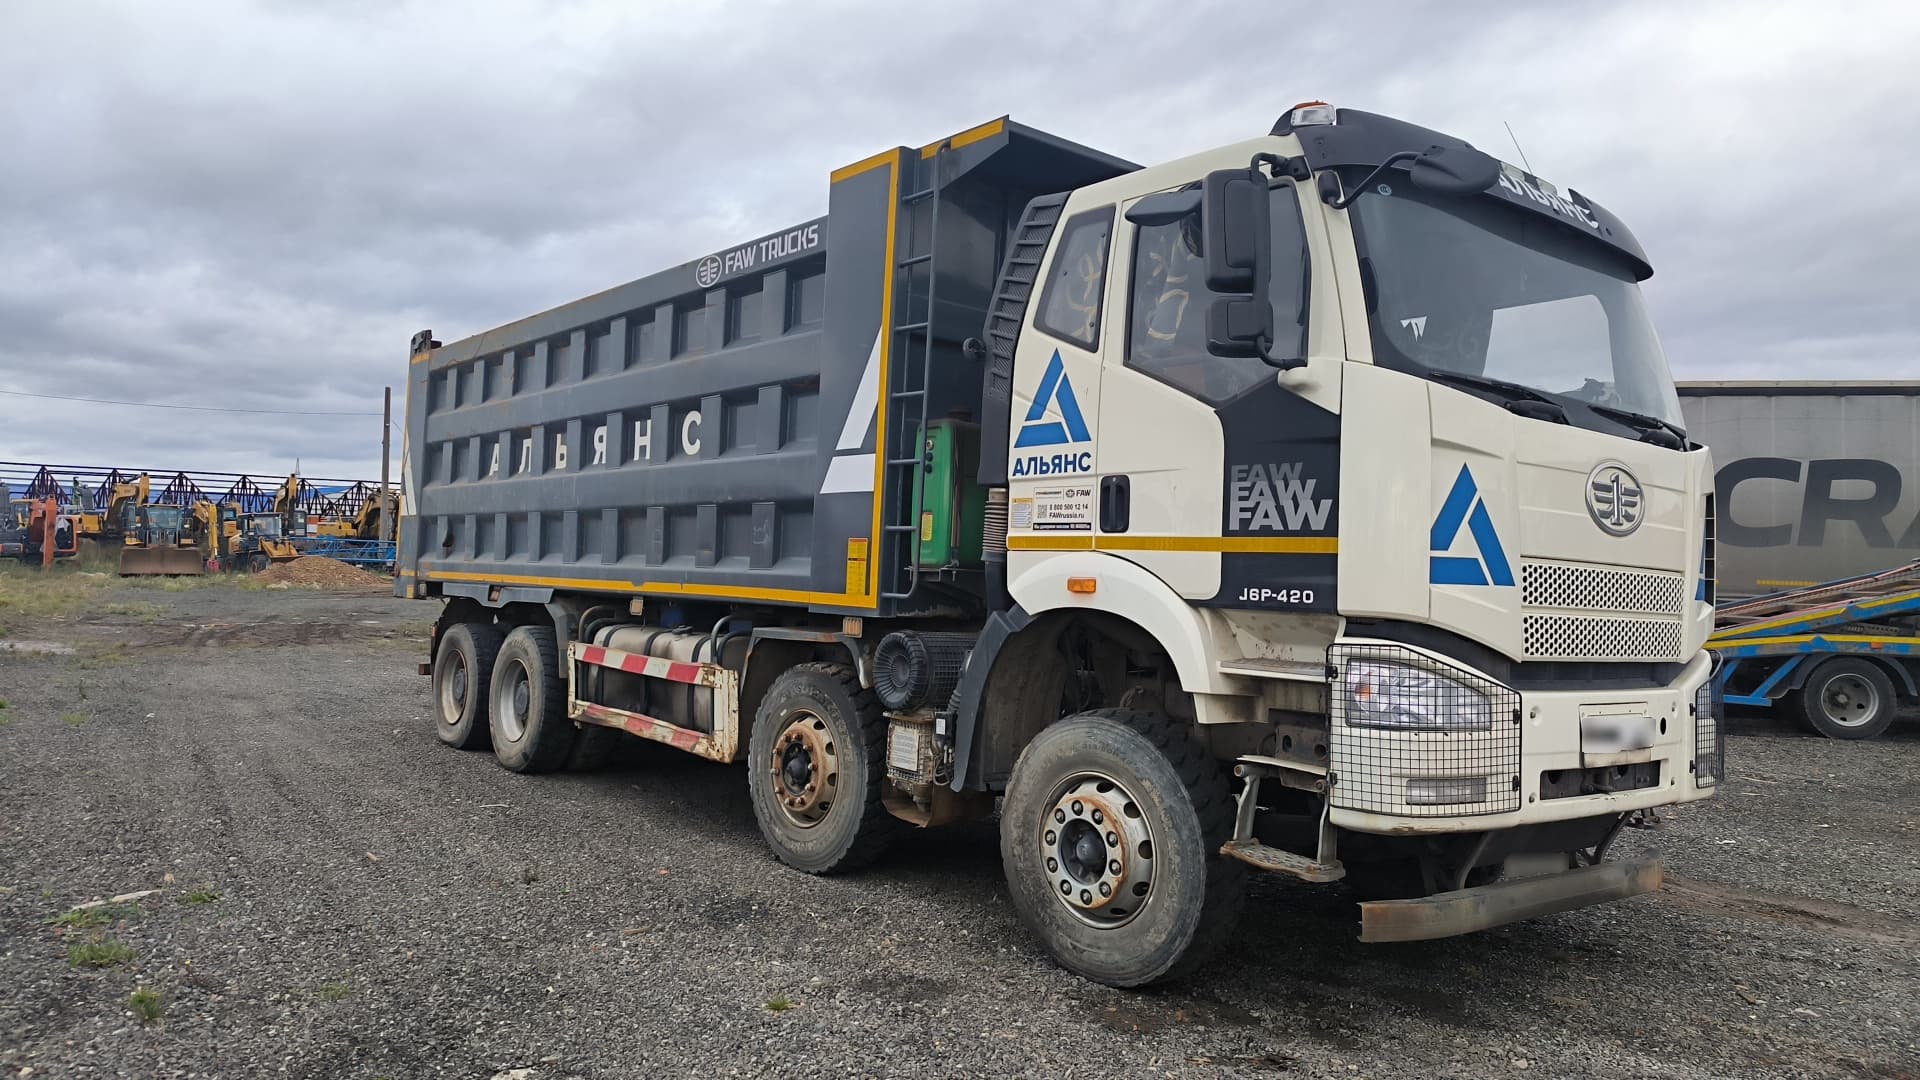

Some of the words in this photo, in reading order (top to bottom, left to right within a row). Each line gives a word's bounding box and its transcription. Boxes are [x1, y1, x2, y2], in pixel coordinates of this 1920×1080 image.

[725, 245, 757, 274] FAW
[760, 224, 819, 262] TRUCKS
[1012, 452, 1092, 476] АЛЬЯНС
[1231, 462, 1304, 485] FAW
[1076, 489, 1092, 497] FAW
[1230, 479, 1317, 506] FAW
[1714, 457, 1920, 548] CR
[1229, 499, 1333, 531] FAW
[1239, 587, 1314, 604] J6P-420
